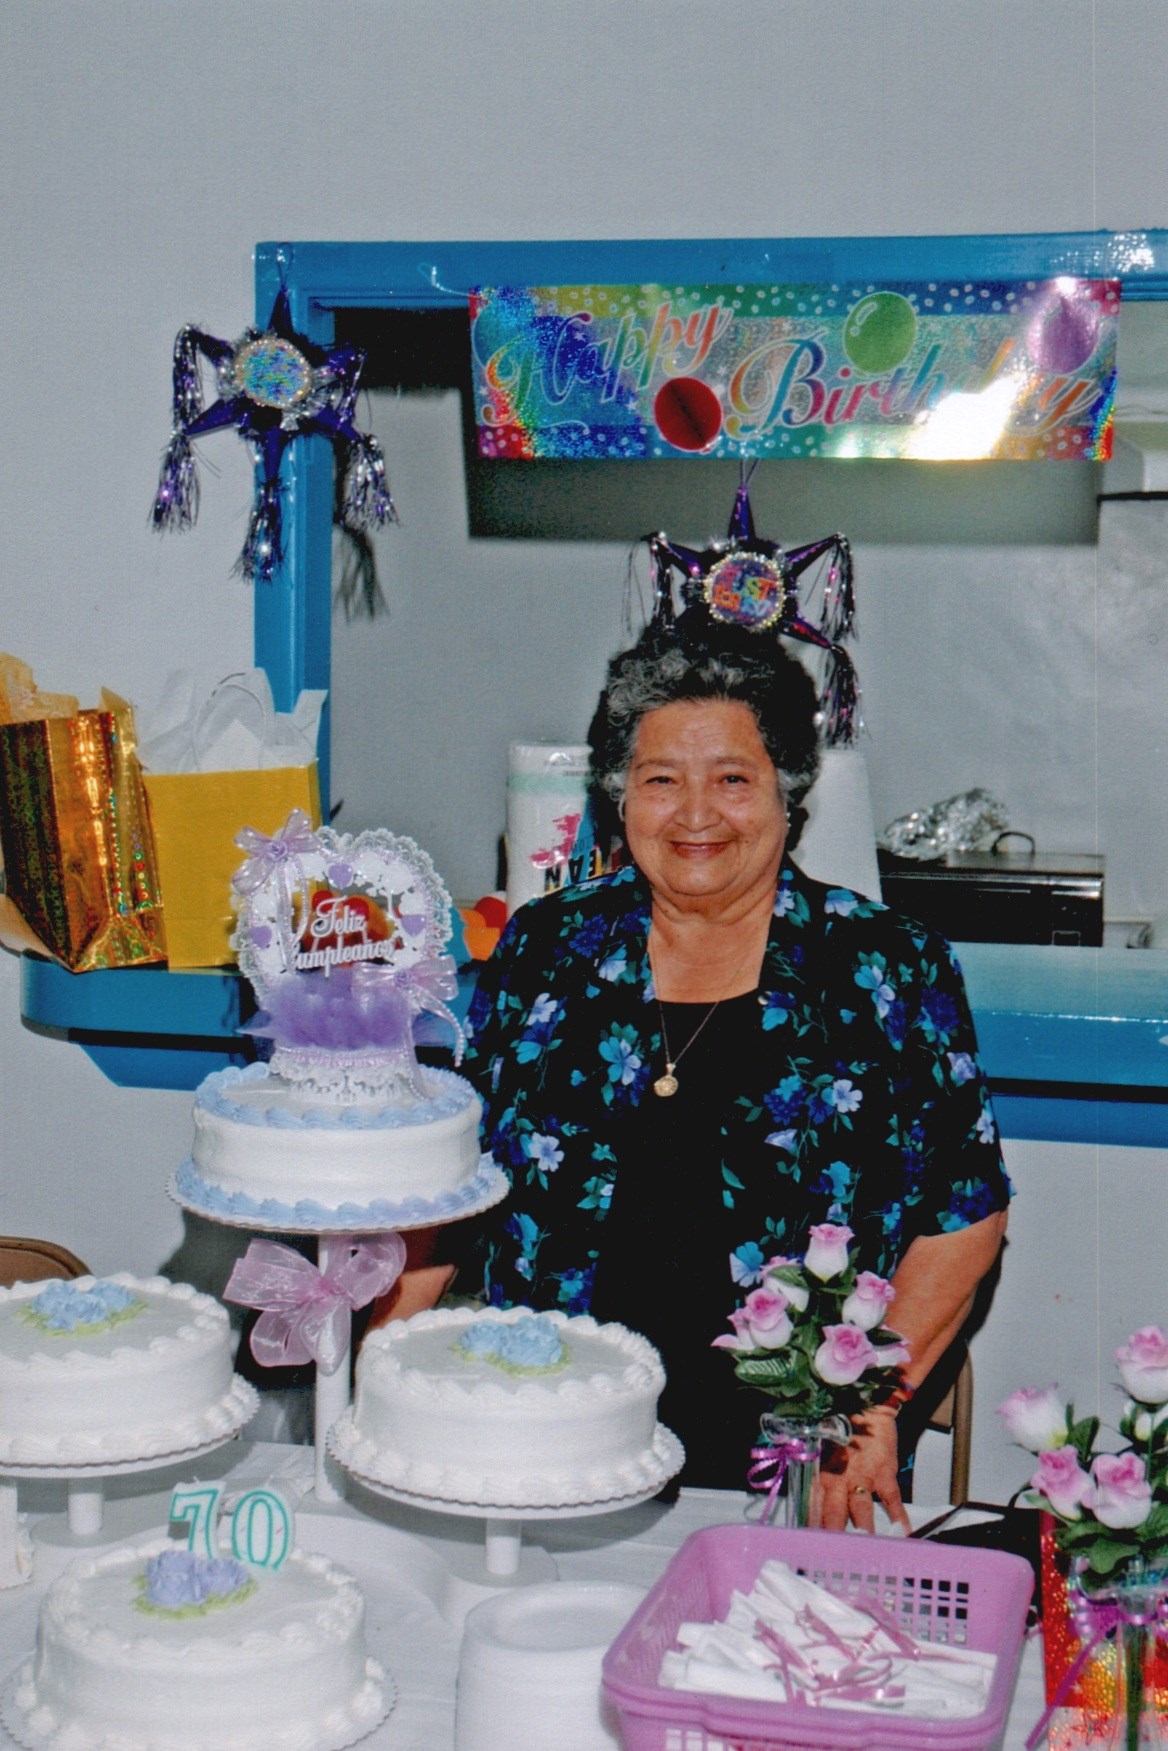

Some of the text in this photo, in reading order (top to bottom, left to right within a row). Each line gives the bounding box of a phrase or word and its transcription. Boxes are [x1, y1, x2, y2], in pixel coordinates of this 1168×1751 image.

[480, 301, 1102, 440] Happy Birthy
[311, 895, 365, 938] Feliz
[168, 1487, 290, 1571] 70
